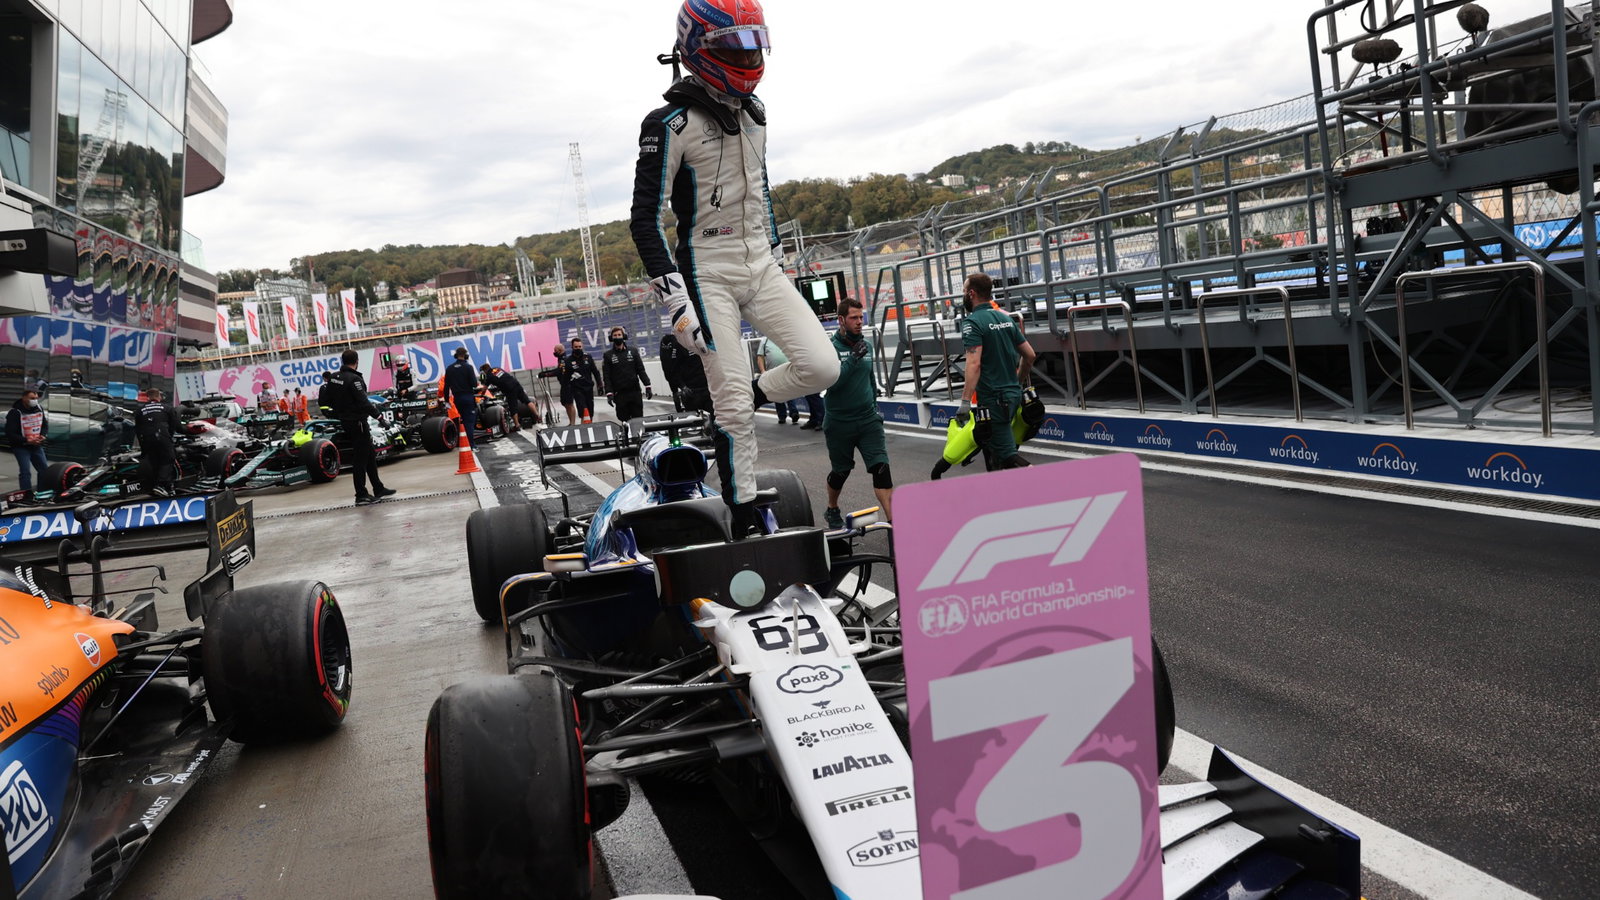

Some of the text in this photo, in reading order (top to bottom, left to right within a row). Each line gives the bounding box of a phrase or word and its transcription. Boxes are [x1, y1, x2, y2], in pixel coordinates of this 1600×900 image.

[670, 115, 685, 130] OMP
[702, 229, 719, 237] OMP
[280, 357, 342, 377] CHANG
[283, 376, 296, 384] THE
[971, 578, 1076, 611] FIA Formula 1
[971, 605, 1020, 628] World
[747, 614, 830, 656] 63
[82, 640, 99, 656] Gulf
[789, 671, 830, 689] pax8
[787, 704, 867, 724] BLACKBIRD.AI
[819, 722, 876, 738] honibe
[812, 753, 895, 780] LAVAZZA
[928, 636, 1143, 900] 3
[139, 796, 172, 821] KAUST
[825, 785, 912, 817] PIRELLI
